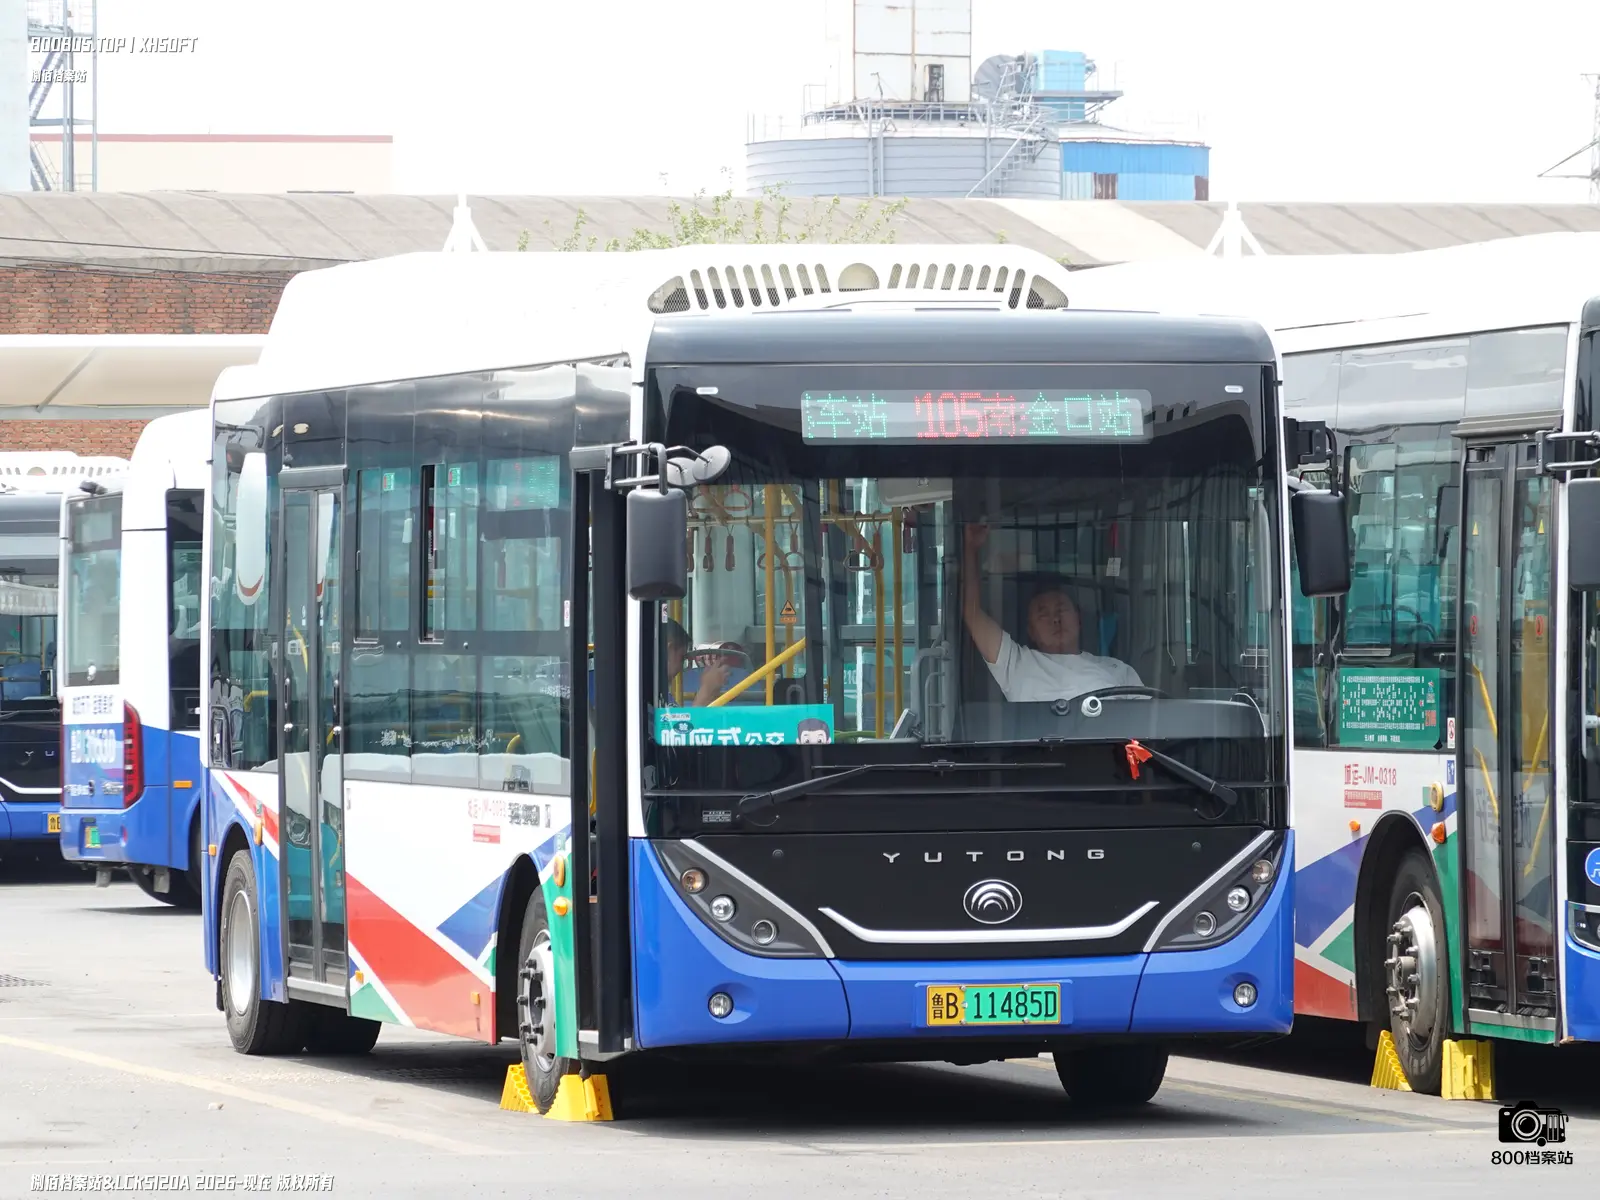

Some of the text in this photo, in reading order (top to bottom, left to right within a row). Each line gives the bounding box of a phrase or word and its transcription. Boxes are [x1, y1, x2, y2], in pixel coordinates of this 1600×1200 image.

[1025, 391, 1132, 436] 金口站
[882, 849, 1105, 864] YUTONG
[931, 990, 1057, 1020] 鲁B 11485D
